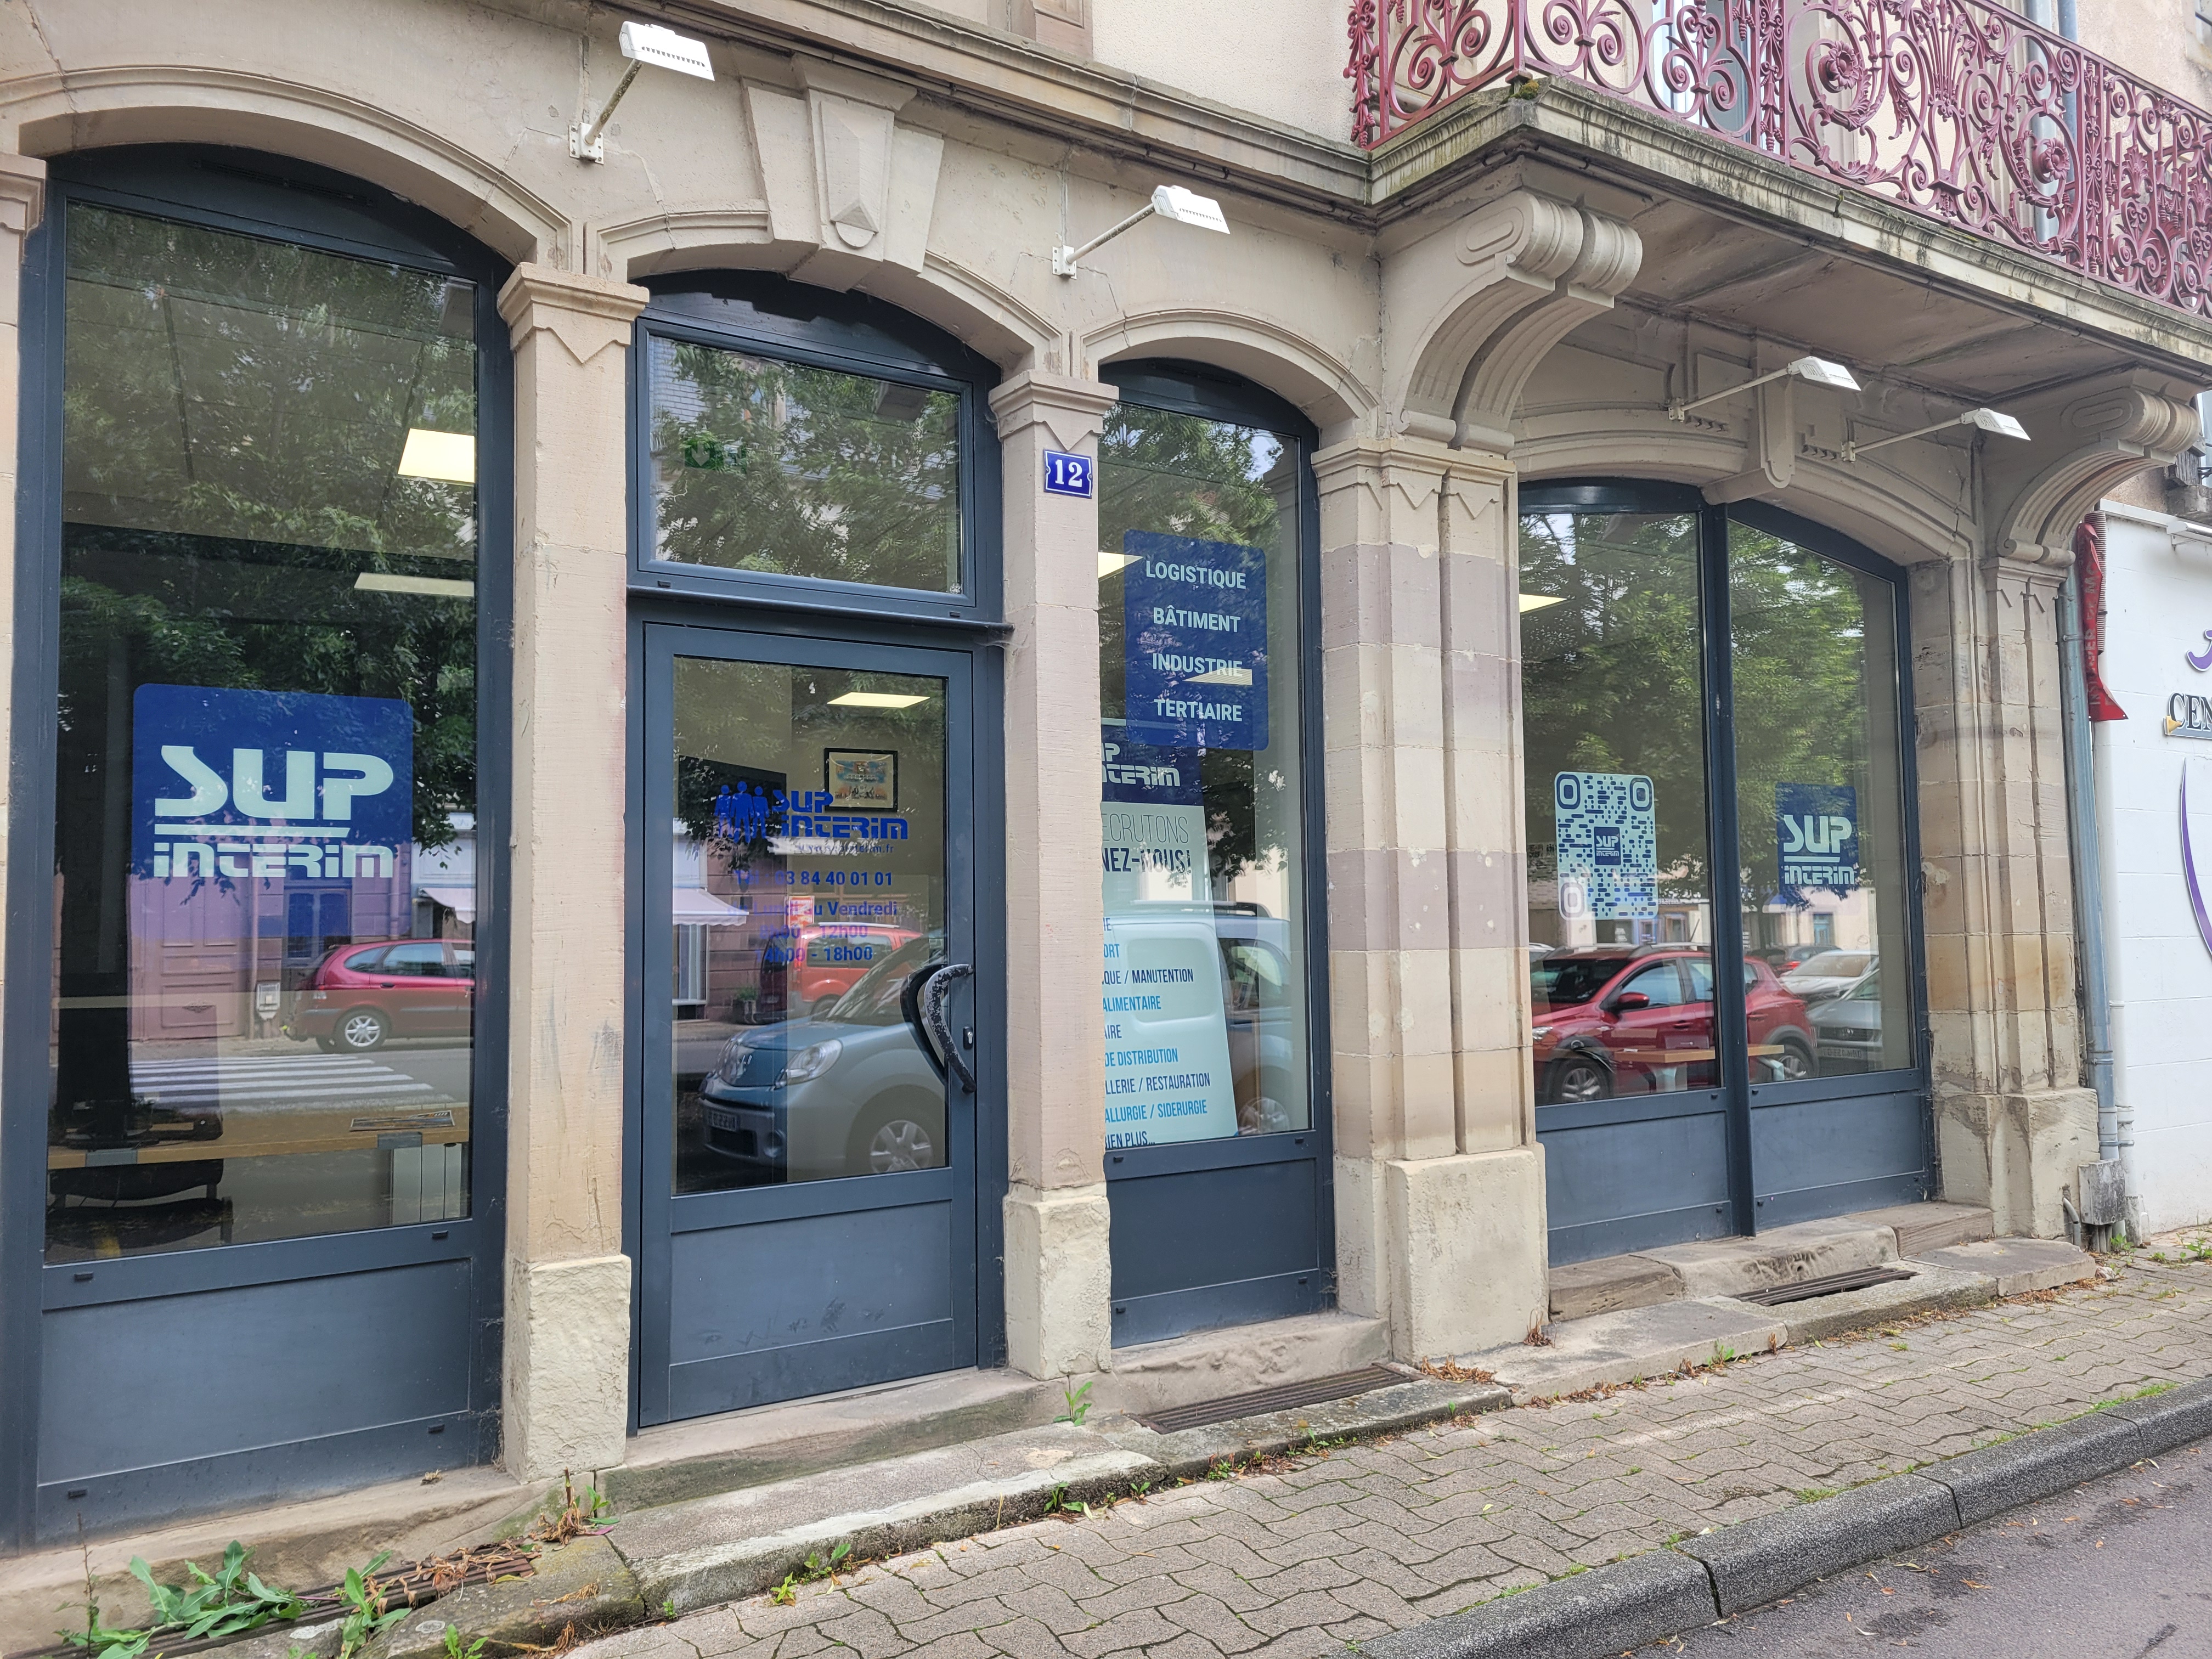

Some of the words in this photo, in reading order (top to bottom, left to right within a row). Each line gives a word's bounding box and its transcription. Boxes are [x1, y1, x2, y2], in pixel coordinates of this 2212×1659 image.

[1055, 459, 1082, 487] 12
[1146, 561, 1246, 590] LOGISTIQUE
[1153, 605, 1241, 633] BÂTIMENT
[1153, 653, 1243, 677] INDUSTRIE
[1154, 698, 1243, 722] TERTIAIRE
[155, 745, 394, 820] SUP
[772, 789, 834, 813] SUP
[1596, 835, 1619, 848] SUP
[1784, 815, 1852, 853] SUP
[775, 870, 795, 885] 03
[800, 871, 820, 885] 84
[826, 871, 845, 885] 40
[850, 872, 868, 886] 01
[874, 872, 892, 886] 01
[827, 901, 897, 916] Vendredi
[759, 924, 800, 940] 8h00
[819, 926, 868, 938] 12h00
[823, 947, 873, 961] 18h00
[1132, 968, 1194, 983] MANUTENTION
[1103, 995, 1161, 1012] ALIMENTAIRE
[1117, 1048, 1178, 1065] DISTRIBUTION
[1146, 1073, 1211, 1091] RESTAURATION
[1105, 1105, 1147, 1123] ALLURGIE
[1157, 1099, 1207, 1118] SIDERURGIE
